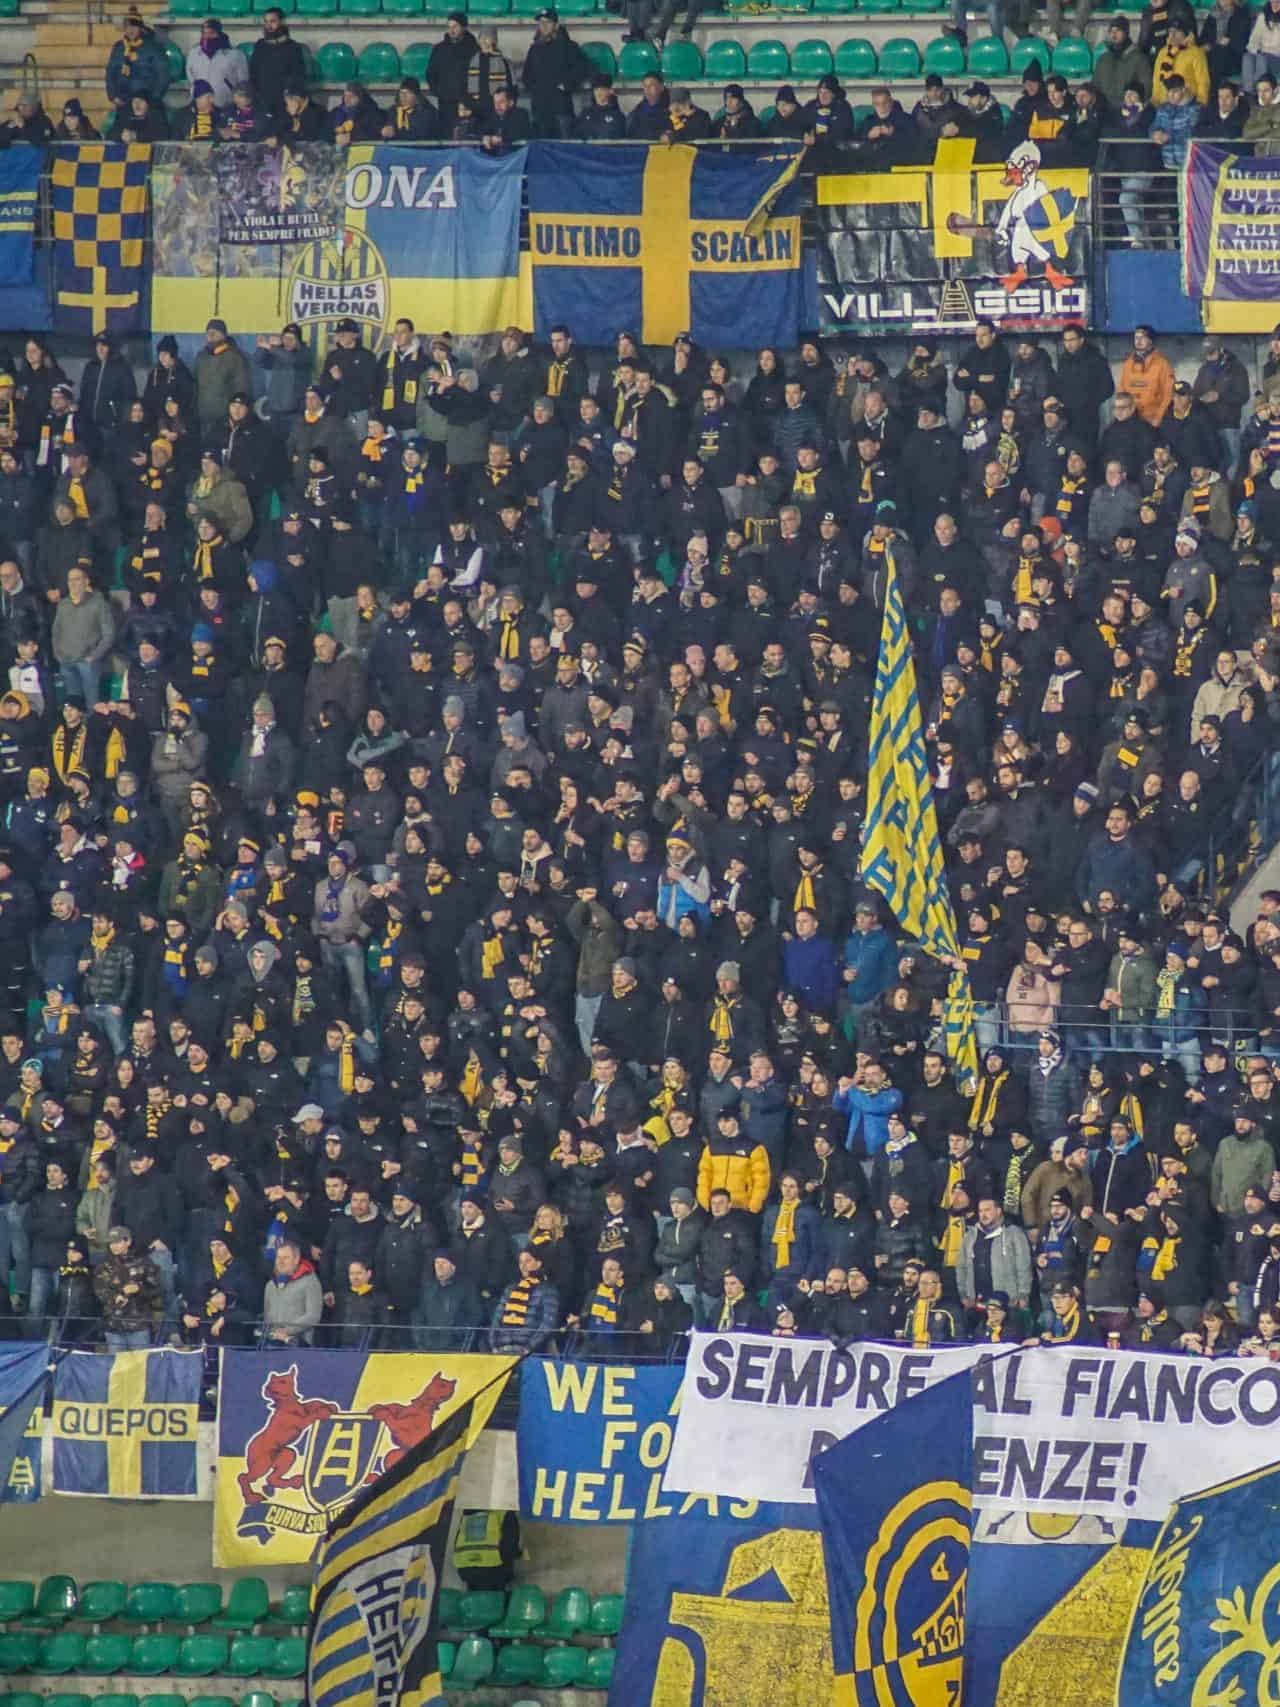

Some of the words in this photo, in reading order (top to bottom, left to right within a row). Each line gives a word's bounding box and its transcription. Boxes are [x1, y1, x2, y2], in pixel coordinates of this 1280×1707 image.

[252, 228, 296, 241] SEMPRE
[535, 223, 641, 258] ULTIMO
[690, 228, 793, 263] SCALIN
[300, 283, 377, 300] HELLAS
[294, 301, 381, 319] VERONA
[543, 1361, 636, 1415] WE
[696, 1338, 935, 1411] SEMPRE
[972, 1354, 1032, 1417] AL
[60, 1406, 188, 1437] QUEPOS
[601, 1421, 673, 1469] FO
[972, 1435, 1146, 1507] ENZE!
[265, 1504, 307, 1532] CURVA
